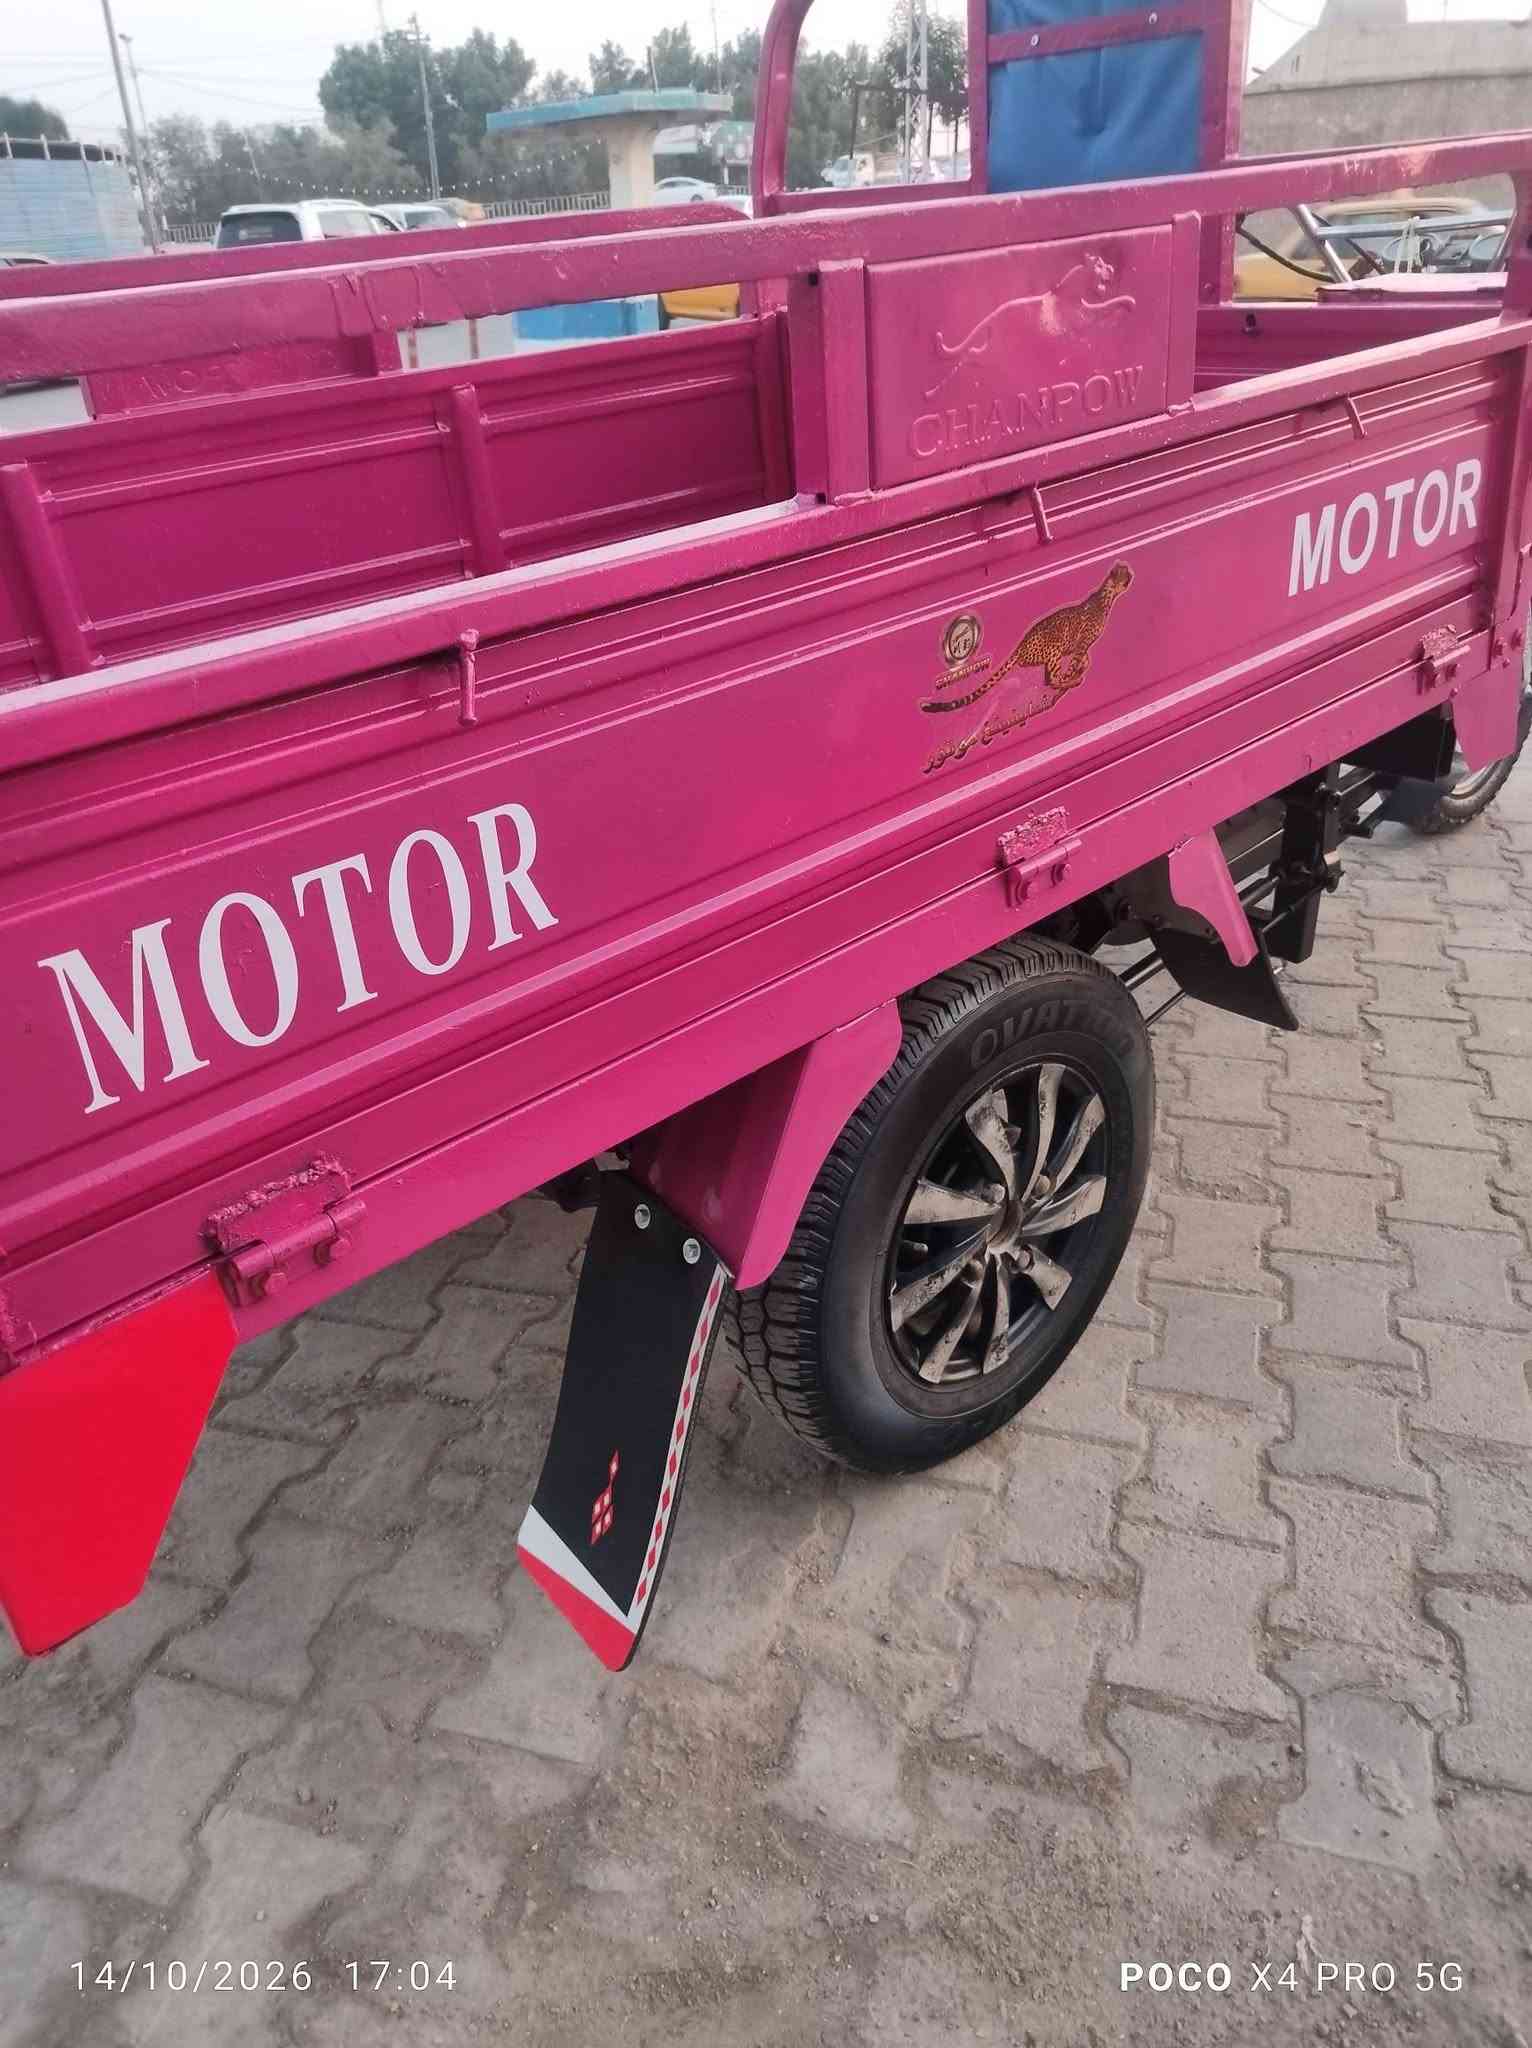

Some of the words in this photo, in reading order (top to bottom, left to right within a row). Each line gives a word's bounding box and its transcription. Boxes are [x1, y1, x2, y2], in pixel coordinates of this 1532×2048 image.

[911, 364, 1144, 457] CHANPOW
[1287, 457, 1482, 597] MOTOR
[37, 803, 559, 1114] MOTOR
